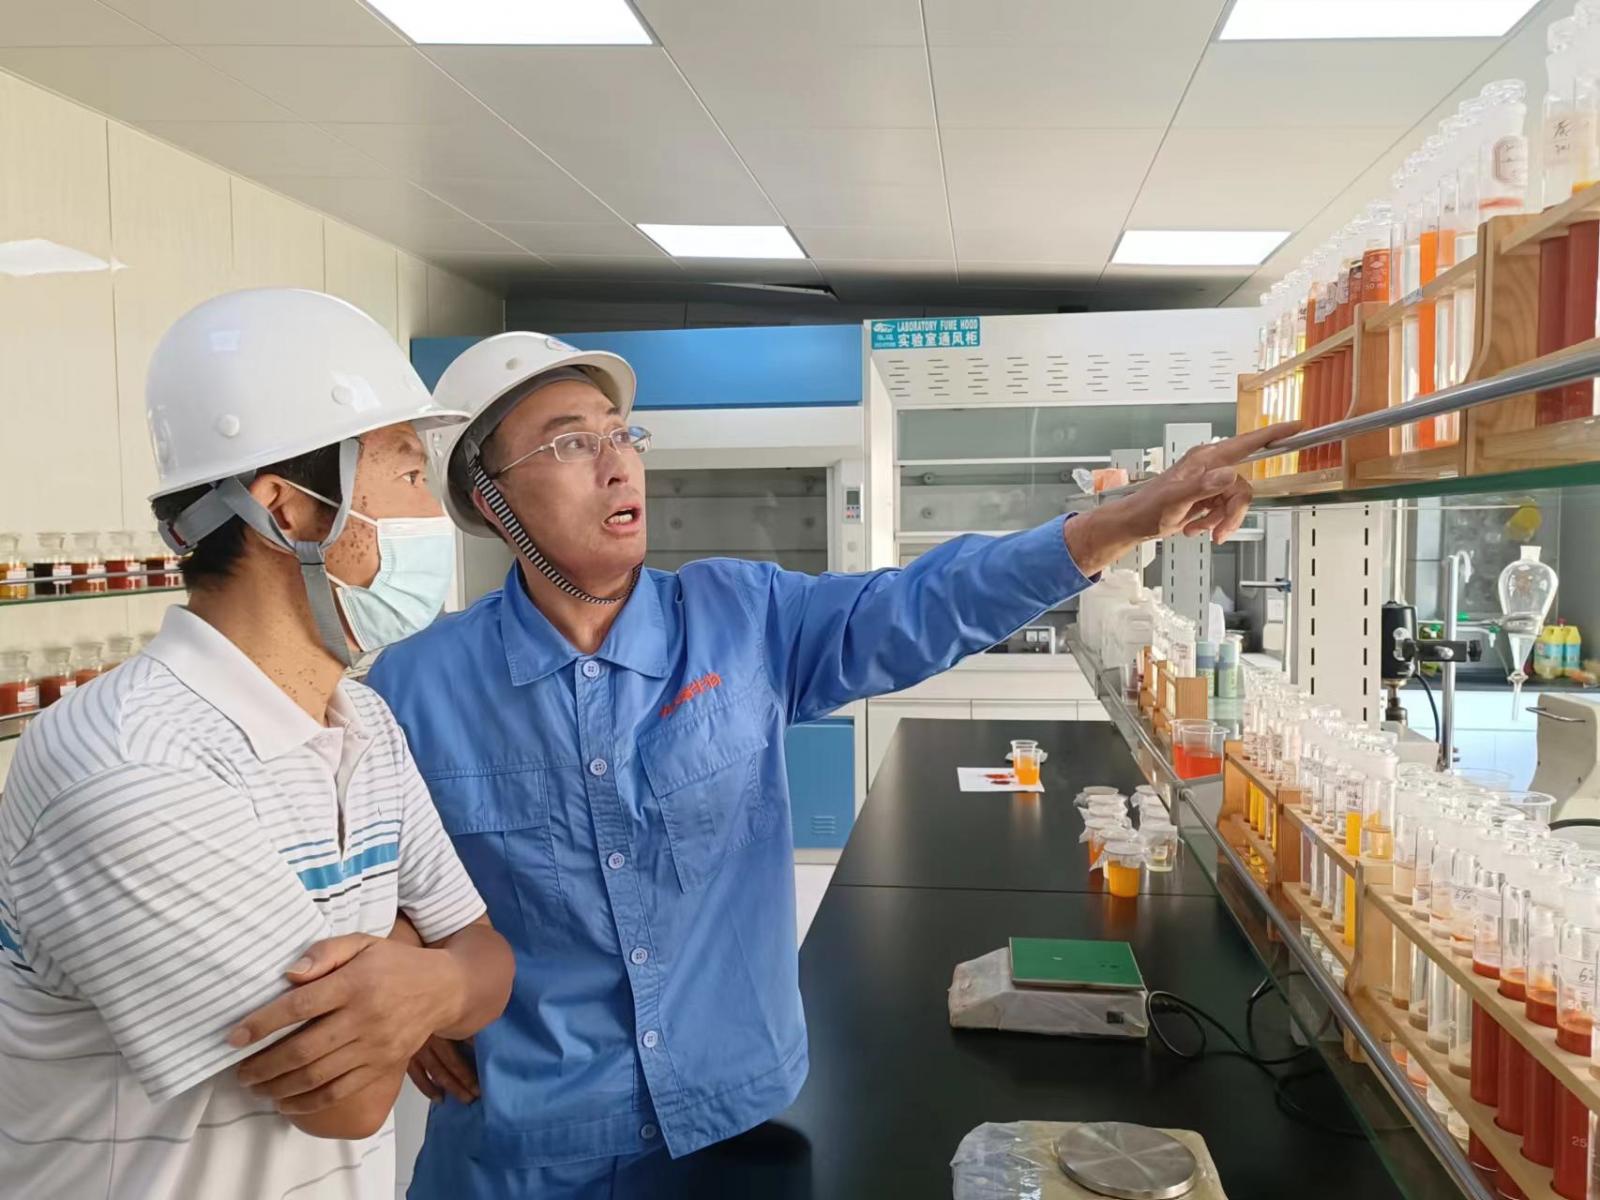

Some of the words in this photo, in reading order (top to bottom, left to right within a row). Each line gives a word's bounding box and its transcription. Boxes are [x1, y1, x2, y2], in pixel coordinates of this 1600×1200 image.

[897, 320, 937, 332] LABORATORY
[940, 319, 957, 331] FUME
[960, 319, 978, 330] HOOD
[898, 331, 978, 347] 实验室通风柜
